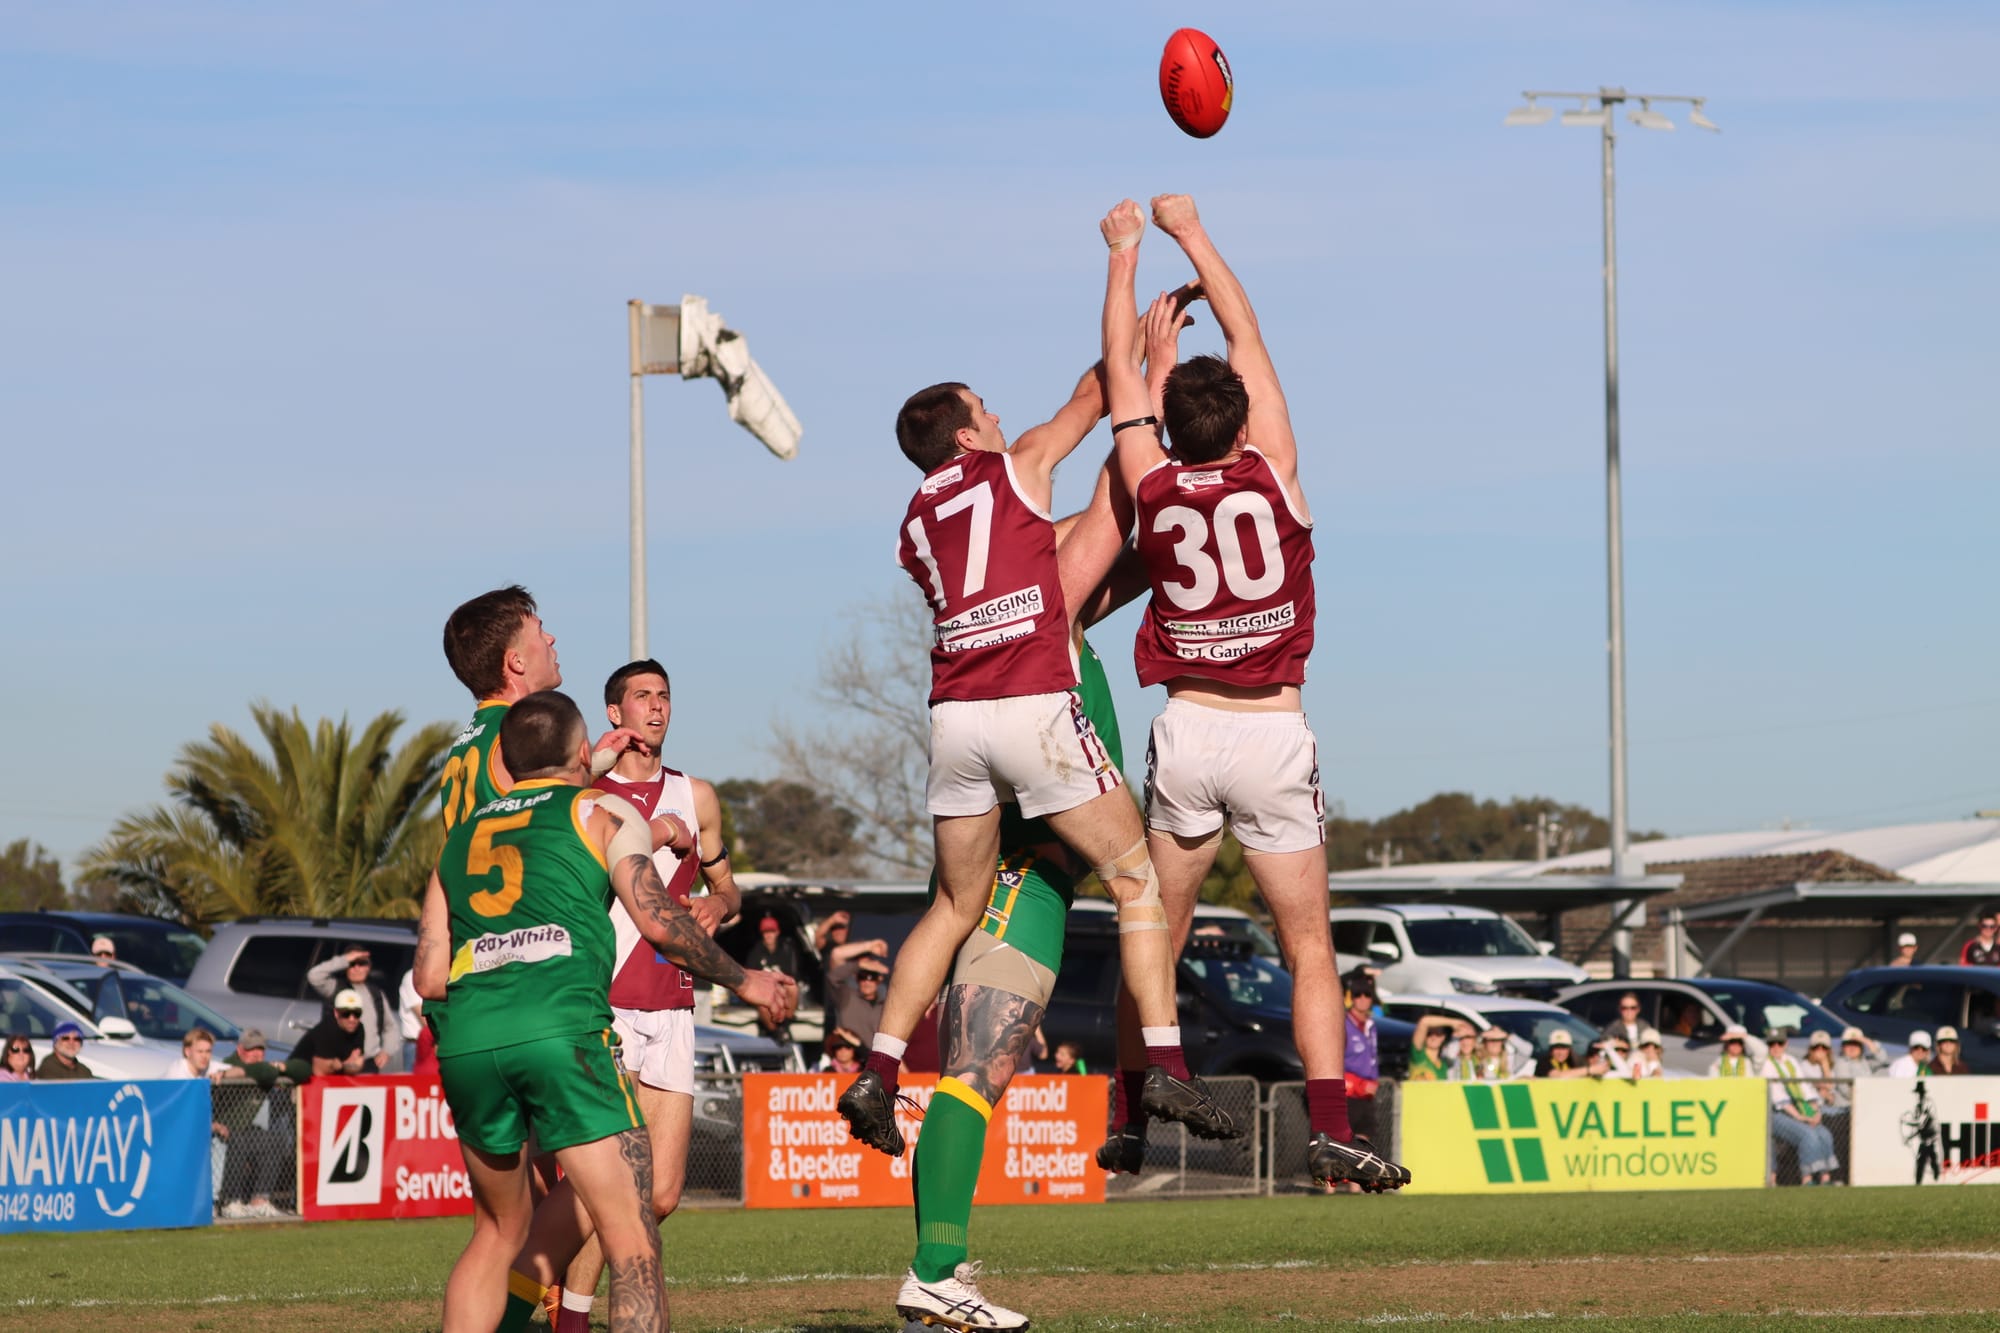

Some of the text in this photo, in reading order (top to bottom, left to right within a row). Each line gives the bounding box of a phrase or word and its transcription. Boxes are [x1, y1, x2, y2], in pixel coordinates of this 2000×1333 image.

[907, 480, 995, 612] 17
[1153, 490, 1285, 611] 30
[970, 589, 1039, 621] RIGGING
[1022, 602, 1040, 614] LTD
[1218, 606, 1291, 629] RIGGING
[1210, 642, 1258, 659] Gardn
[467, 812, 533, 917] 5
[394, 1084, 459, 1140] Bri
[769, 1079, 837, 1113] arnold
[1006, 1080, 1068, 1112] arnold
[768, 1114, 849, 1147] thomas
[1006, 1113, 1078, 1145] thomas
[1549, 1099, 1728, 1140] VALLEY
[0, 1115, 138, 1187] NAWAY
[769, 1147, 863, 1181] & becker
[1004, 1145, 1089, 1179] & becker
[1563, 1144, 1719, 1178] windows
[32, 1191, 76, 1222] 9408
